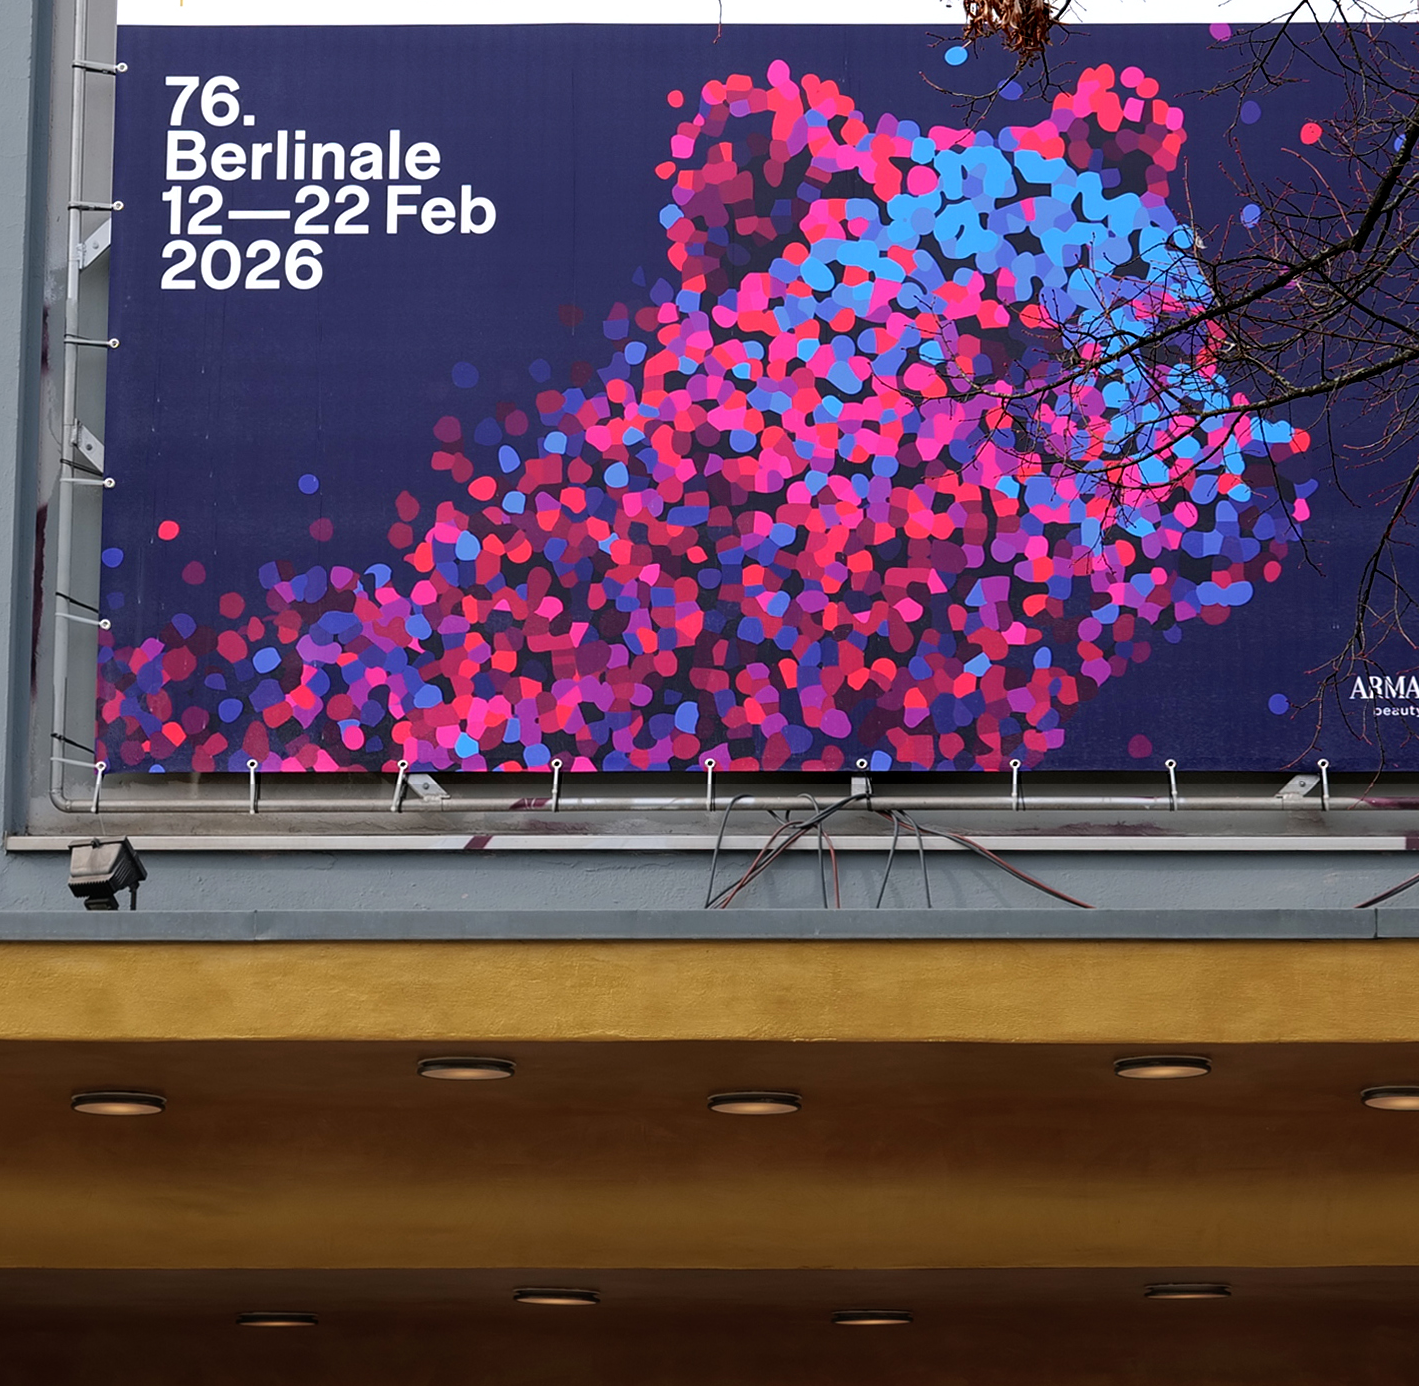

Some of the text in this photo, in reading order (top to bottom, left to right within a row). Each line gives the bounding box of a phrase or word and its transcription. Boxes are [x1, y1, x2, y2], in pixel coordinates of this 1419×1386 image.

[165, 76, 255, 127] 76.
[165, 130, 441, 181] Berlinale
[386, 184, 497, 235] Feb
[161, 239, 323, 290] 2026
